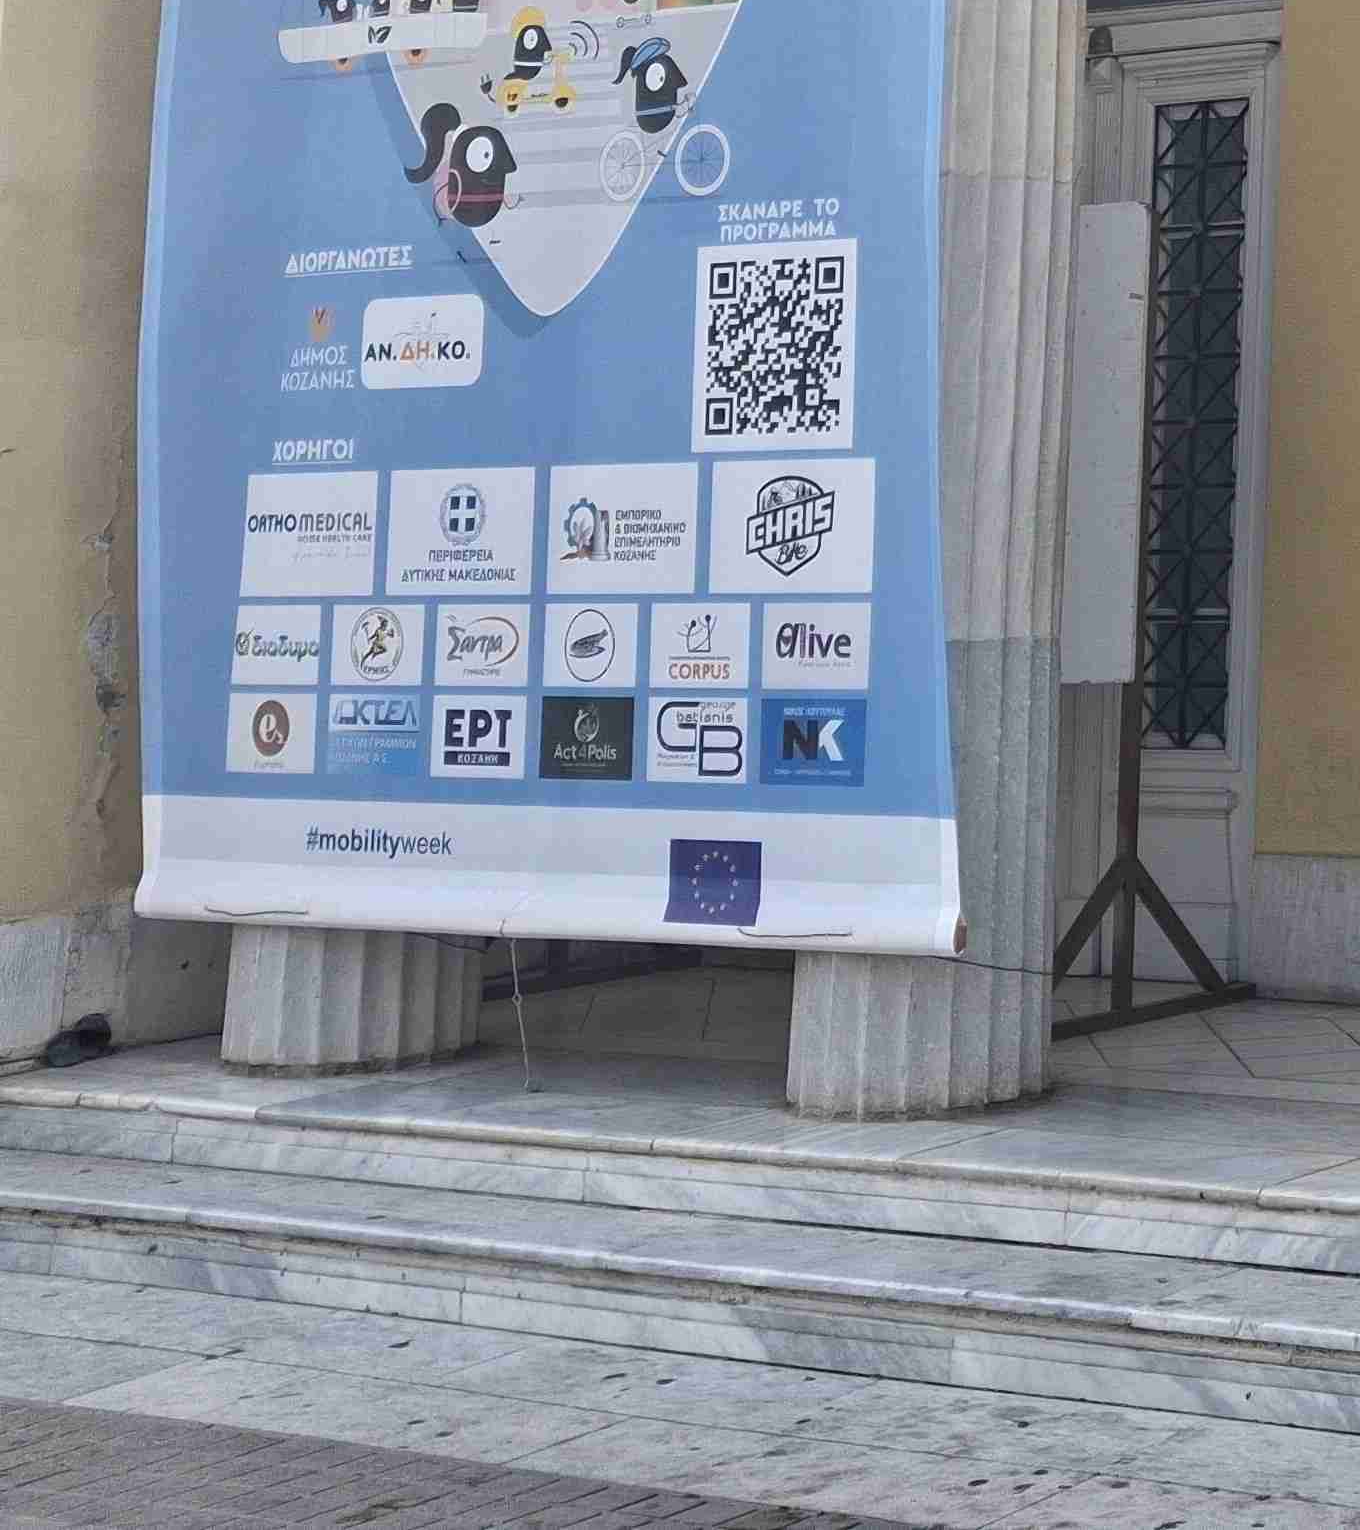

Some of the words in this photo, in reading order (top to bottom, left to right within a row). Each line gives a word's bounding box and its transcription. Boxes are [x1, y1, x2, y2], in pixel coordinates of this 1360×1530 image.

[814, 197, 840, 217] ΤΟ
[720, 220, 837, 243] ΠΡΟΓΡΑΜΜΑ
[284, 245, 414, 275] ΔΙΟΡΓΑΝΩΤΕΣ
[289, 345, 348, 368] ΔΗΜΟΣ
[280, 369, 356, 392] ΚΟΖΑΝΗΣ
[271, 437, 354, 463] ΧΟΡΗΓΟΙ
[428, 549, 494, 563] ΠΕΡΙΦΕΡΕΙΑ
[401, 569, 446, 583] ΔΥΤΙΚΗΣ
[448, 568, 516, 583] ΜΑΚΕΔΟΝΙΑΣ
[668, 662, 730, 680] CORPUS
[444, 709, 513, 748] ΕΡΤ
[306, 826, 452, 860] #mobilityweek
